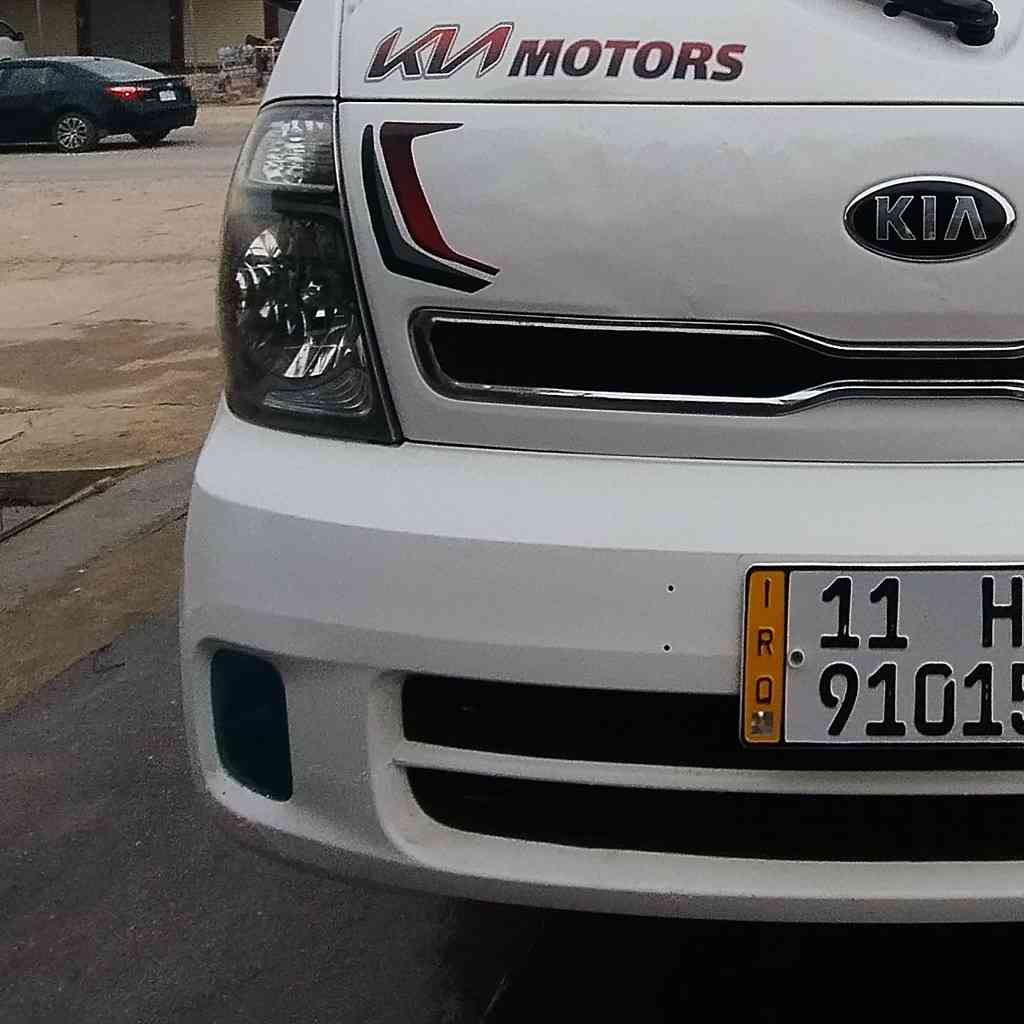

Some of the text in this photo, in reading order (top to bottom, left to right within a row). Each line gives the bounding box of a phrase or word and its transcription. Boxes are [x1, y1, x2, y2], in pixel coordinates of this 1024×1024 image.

[507, 39, 747, 81] MOTORS
[875, 196, 987, 240] KIA
[820, 576, 909, 649] 11
[981, 576, 1024, 649] H
